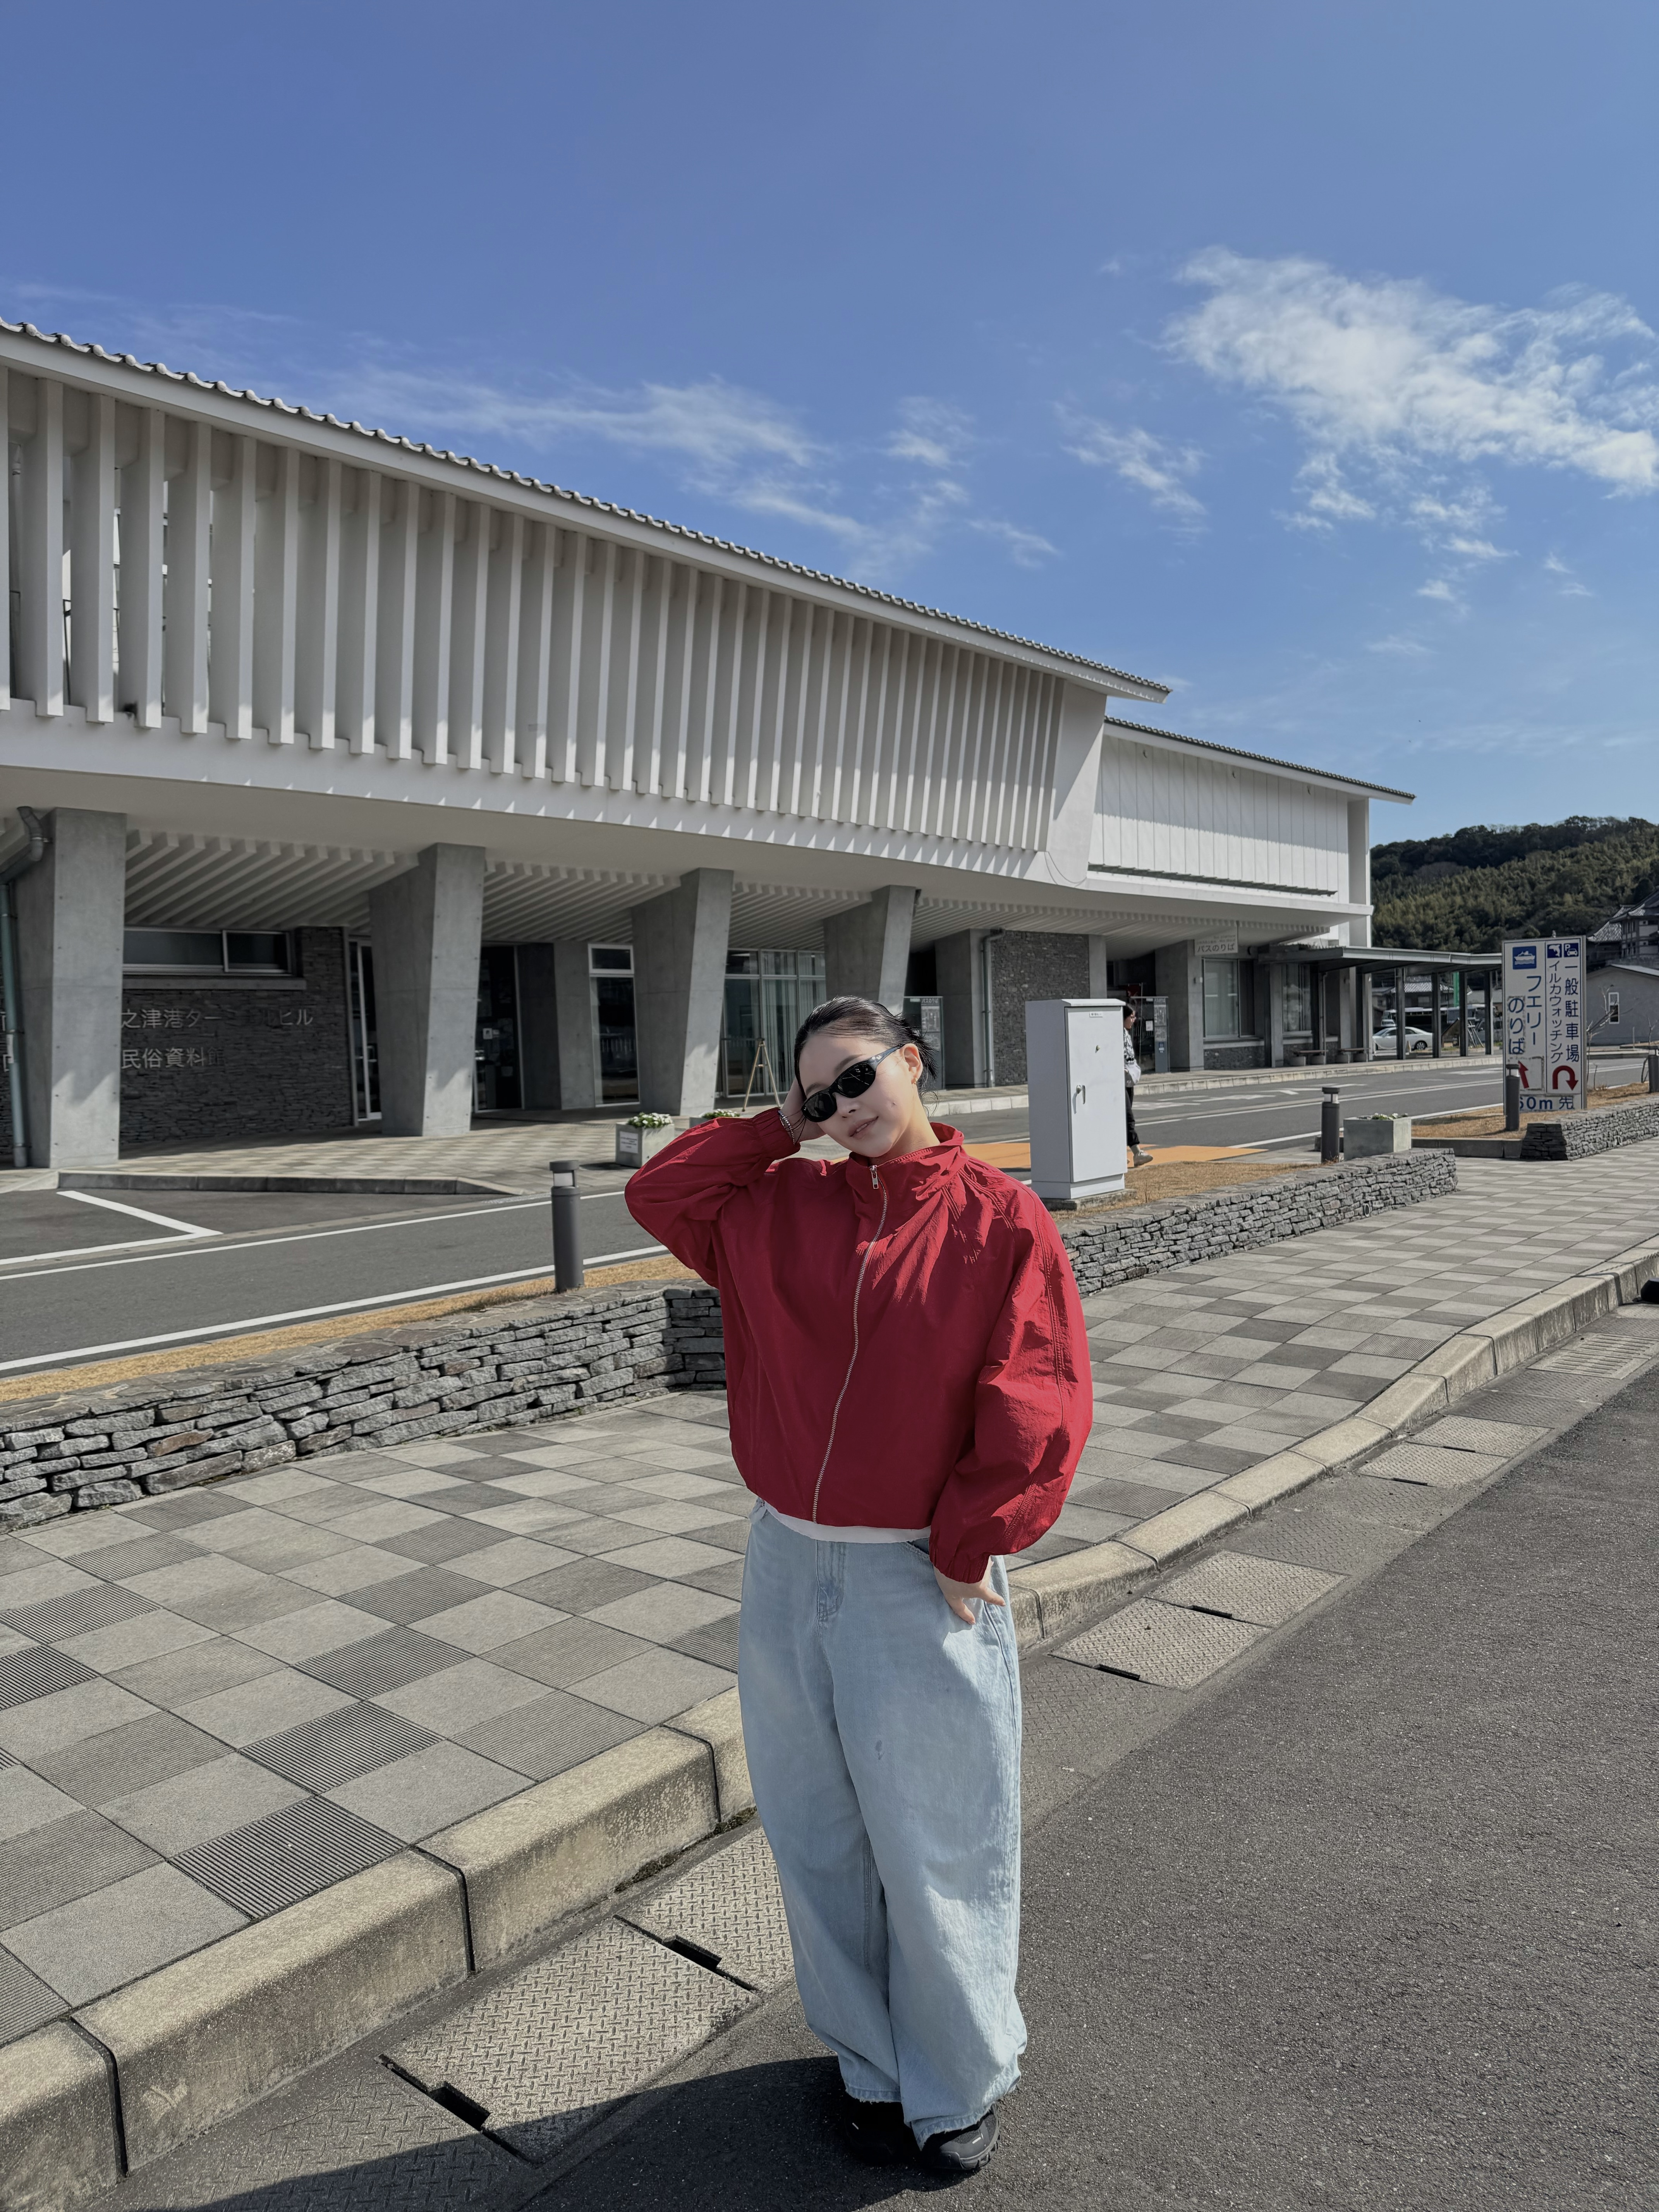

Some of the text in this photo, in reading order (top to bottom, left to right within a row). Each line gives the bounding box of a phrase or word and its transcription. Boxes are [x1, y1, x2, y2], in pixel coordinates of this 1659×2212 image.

[1197, 943, 1235, 952] バスのりば
[1508, 998, 1525, 1054] のりば
[1549, 960, 1563, 1063] イルカウォッチング
[1565, 965, 1579, 1062] 一般駐車場
[1559, 1096, 1575, 1109] 先
